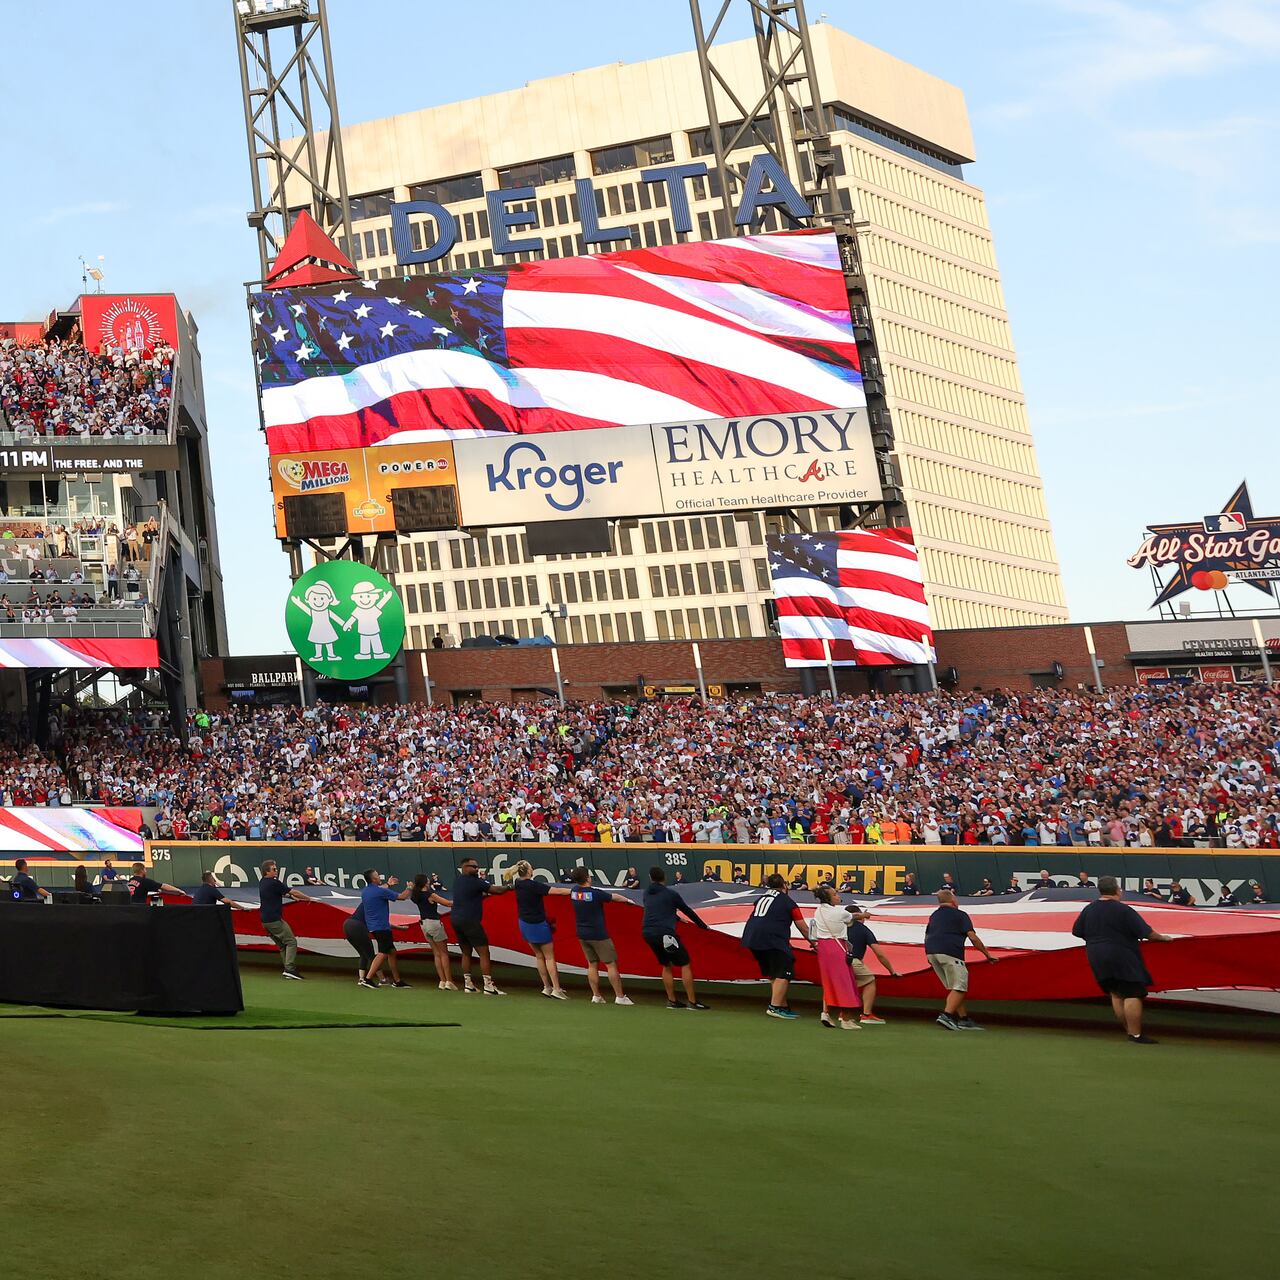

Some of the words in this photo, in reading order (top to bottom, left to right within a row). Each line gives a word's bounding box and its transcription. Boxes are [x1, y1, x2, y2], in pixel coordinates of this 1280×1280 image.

[390, 154, 814, 266] DELTA
[662, 411, 858, 464] EMORY
[22, 451, 48, 467] PM
[54, 459, 72, 469] THE
[103, 459, 123, 468] AND
[125, 458, 143, 468] THE
[302, 460, 349, 479] MEGA
[486, 442, 623, 512] Kroger
[672, 459, 858, 488] HEALTHCARE
[300, 474, 350, 491] MILLIONS
[675, 497, 714, 509] Official
[717, 495, 748, 507] Team
[751, 493, 815, 505] Healthcare
[818, 489, 869, 501] Provider
[1128, 535, 1182, 567] All
[1183, 533, 1246, 563] Star
[1236, 571, 1267, 579] ATLANTA
[151, 848, 171, 861] 375
[665, 852, 688, 866] 385
[754, 896, 775, 917] 10
